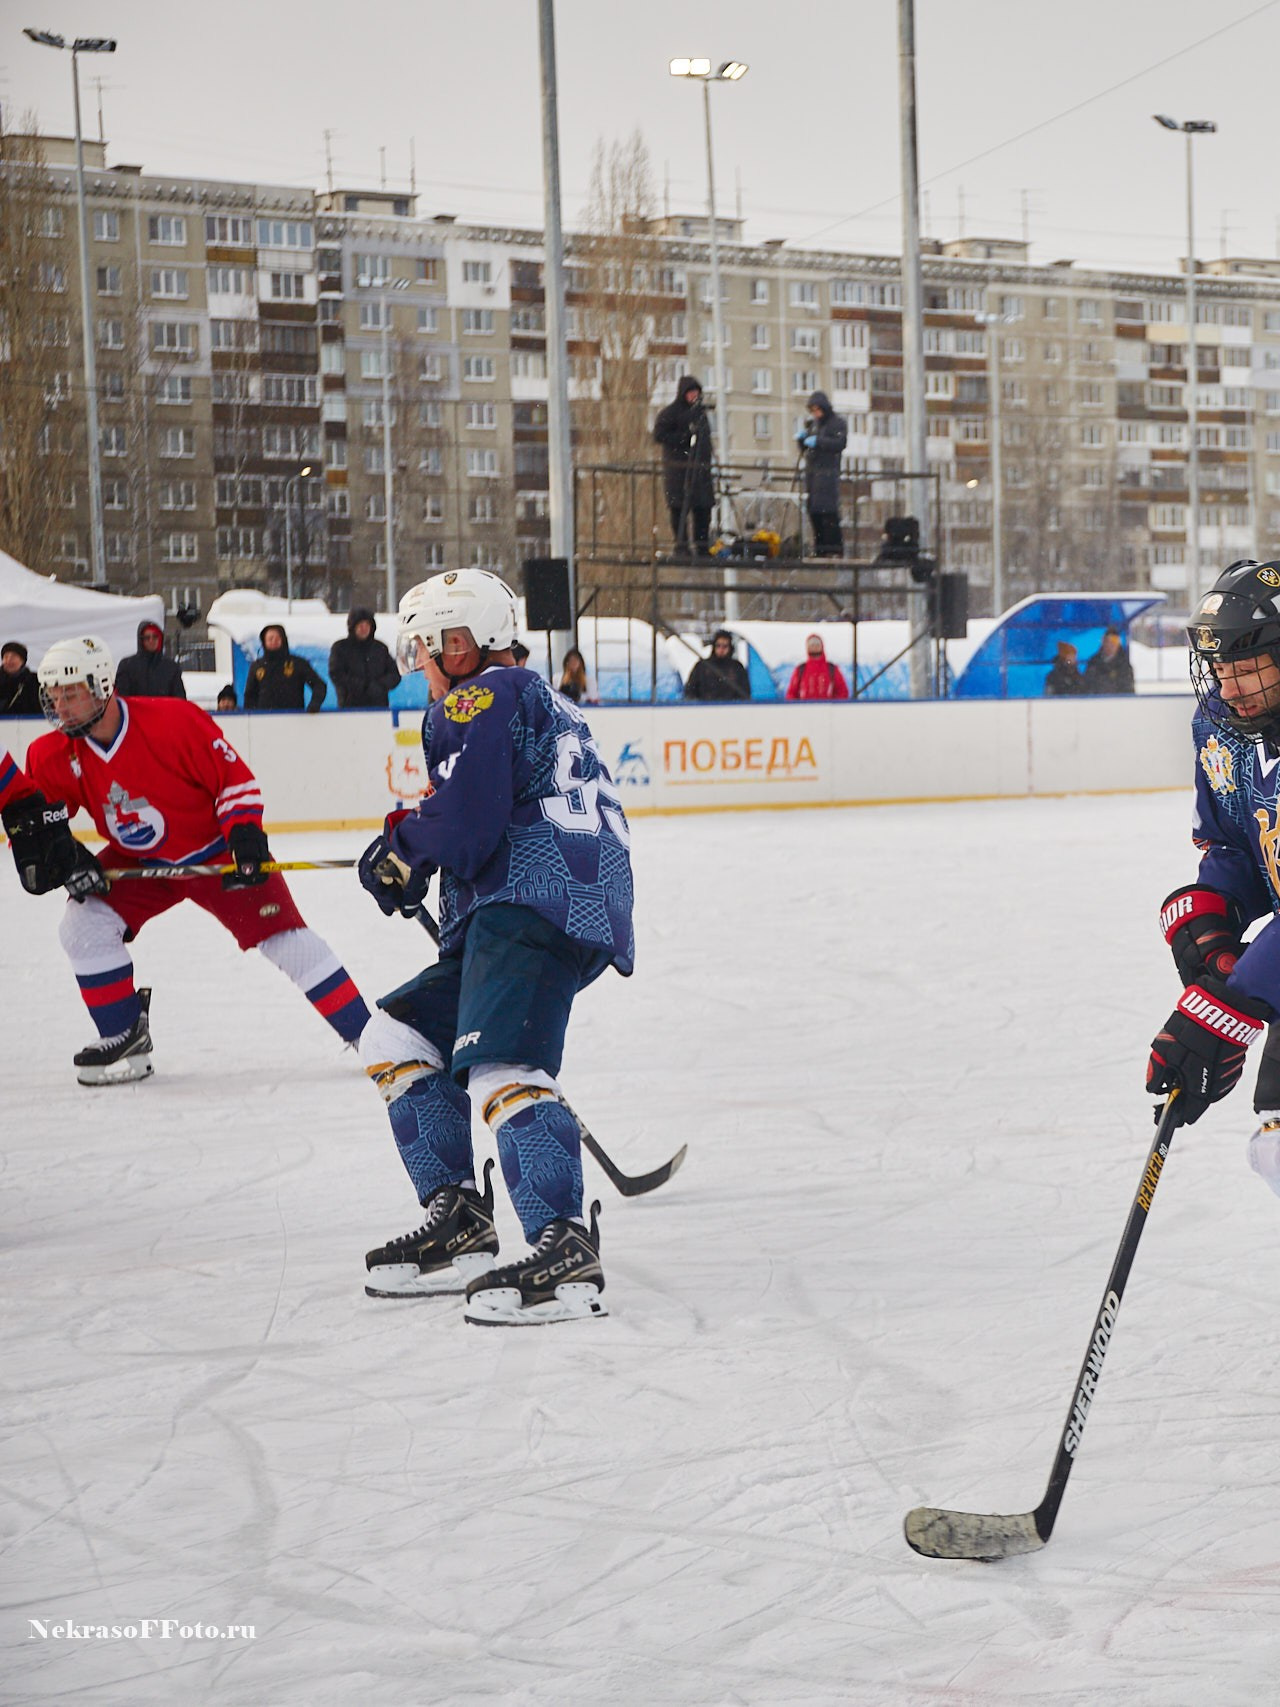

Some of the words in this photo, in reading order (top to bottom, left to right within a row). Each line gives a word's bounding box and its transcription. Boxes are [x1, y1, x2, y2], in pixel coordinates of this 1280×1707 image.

[663, 736, 818, 776] ПОБЕДА
[1137, 1151, 1164, 1212] REKKER
[445, 1222, 481, 1251] CCM
[532, 1251, 584, 1287] CCM
